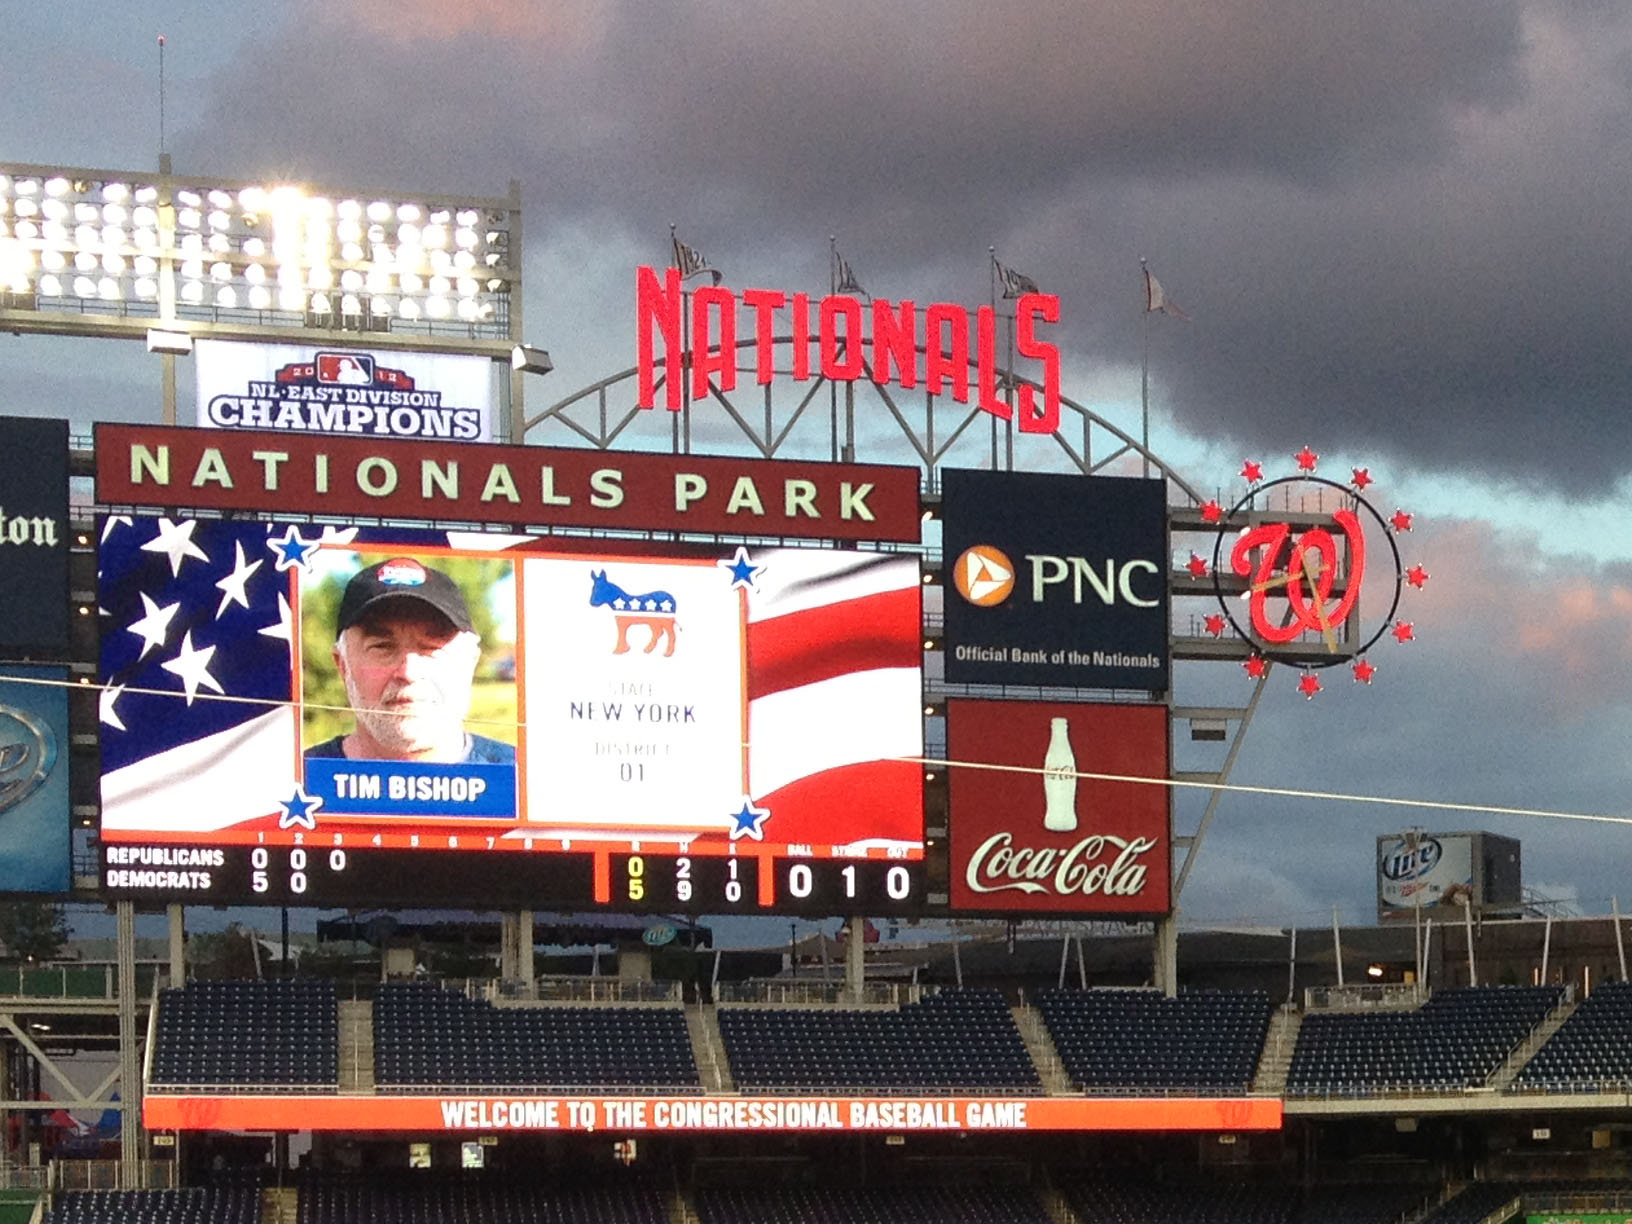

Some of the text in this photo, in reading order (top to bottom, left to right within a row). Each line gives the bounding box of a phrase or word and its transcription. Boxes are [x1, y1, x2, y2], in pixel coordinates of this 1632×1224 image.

[636, 265, 1060, 434] NATIONALS
[346, 389, 439, 408] DIVISION
[210, 398, 480, 439] CHAMPIONS
[131, 444, 876, 521] NATIONALS PARK
[1025, 555, 1160, 608] PNC
[956, 644, 1160, 669] Official Bank of the Nationals
[570, 704, 696, 724] NEW YORK
[333, 774, 486, 802] TIM BISHOP
[620, 764, 644, 781] 01
[258, 833, 264, 844] 1
[295, 833, 304, 845] 2
[334, 833, 343, 846] 3
[486, 837, 495, 850] 7
[106, 847, 738, 879] REPUBLICANS 0 0 0 0 2 1
[966, 832, 1159, 896] Coca-Cola
[106, 871, 741, 902] DEMOCRATS 5 0 5 9 0
[789, 864, 910, 900] 0 1 0
[442, 1101, 1027, 1129] WELCOME TO THE CONGRESSIONAL BASEBALL GAME
